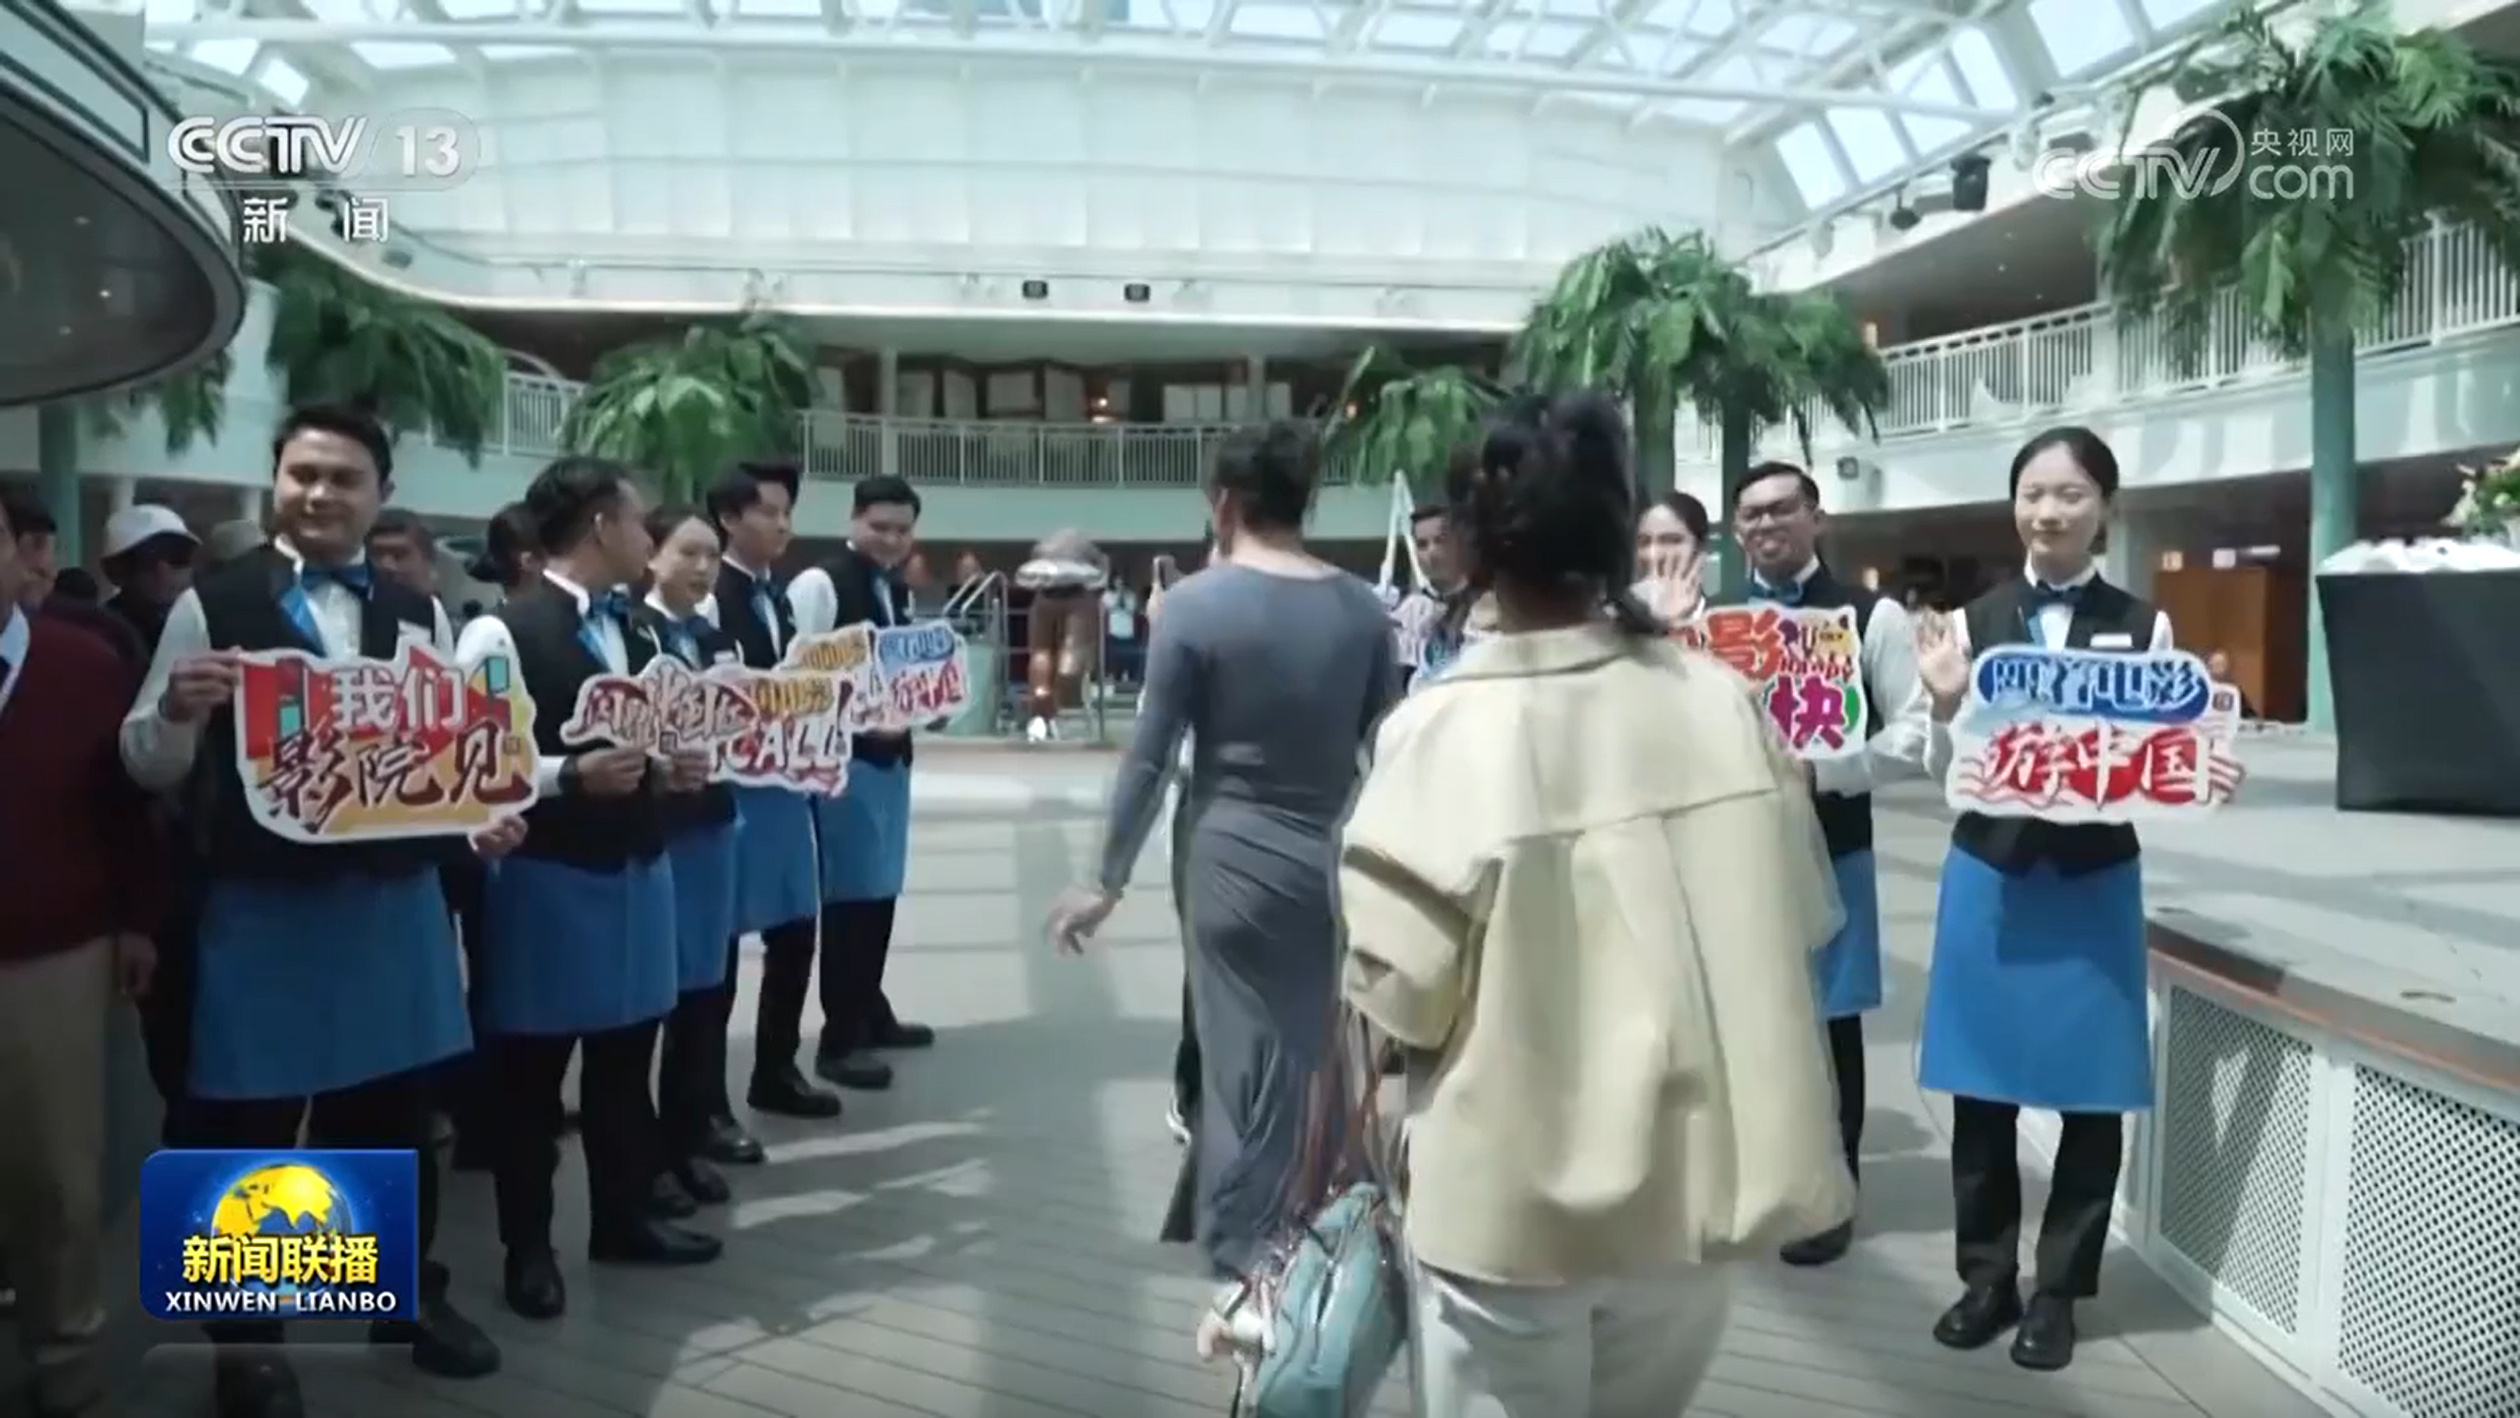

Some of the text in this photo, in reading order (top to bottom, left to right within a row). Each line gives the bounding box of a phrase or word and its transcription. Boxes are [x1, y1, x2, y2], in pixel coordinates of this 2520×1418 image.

[331, 665, 464, 729] 我们
[257, 717, 534, 834] 影院见
[1984, 718, 2211, 811] 游中国
